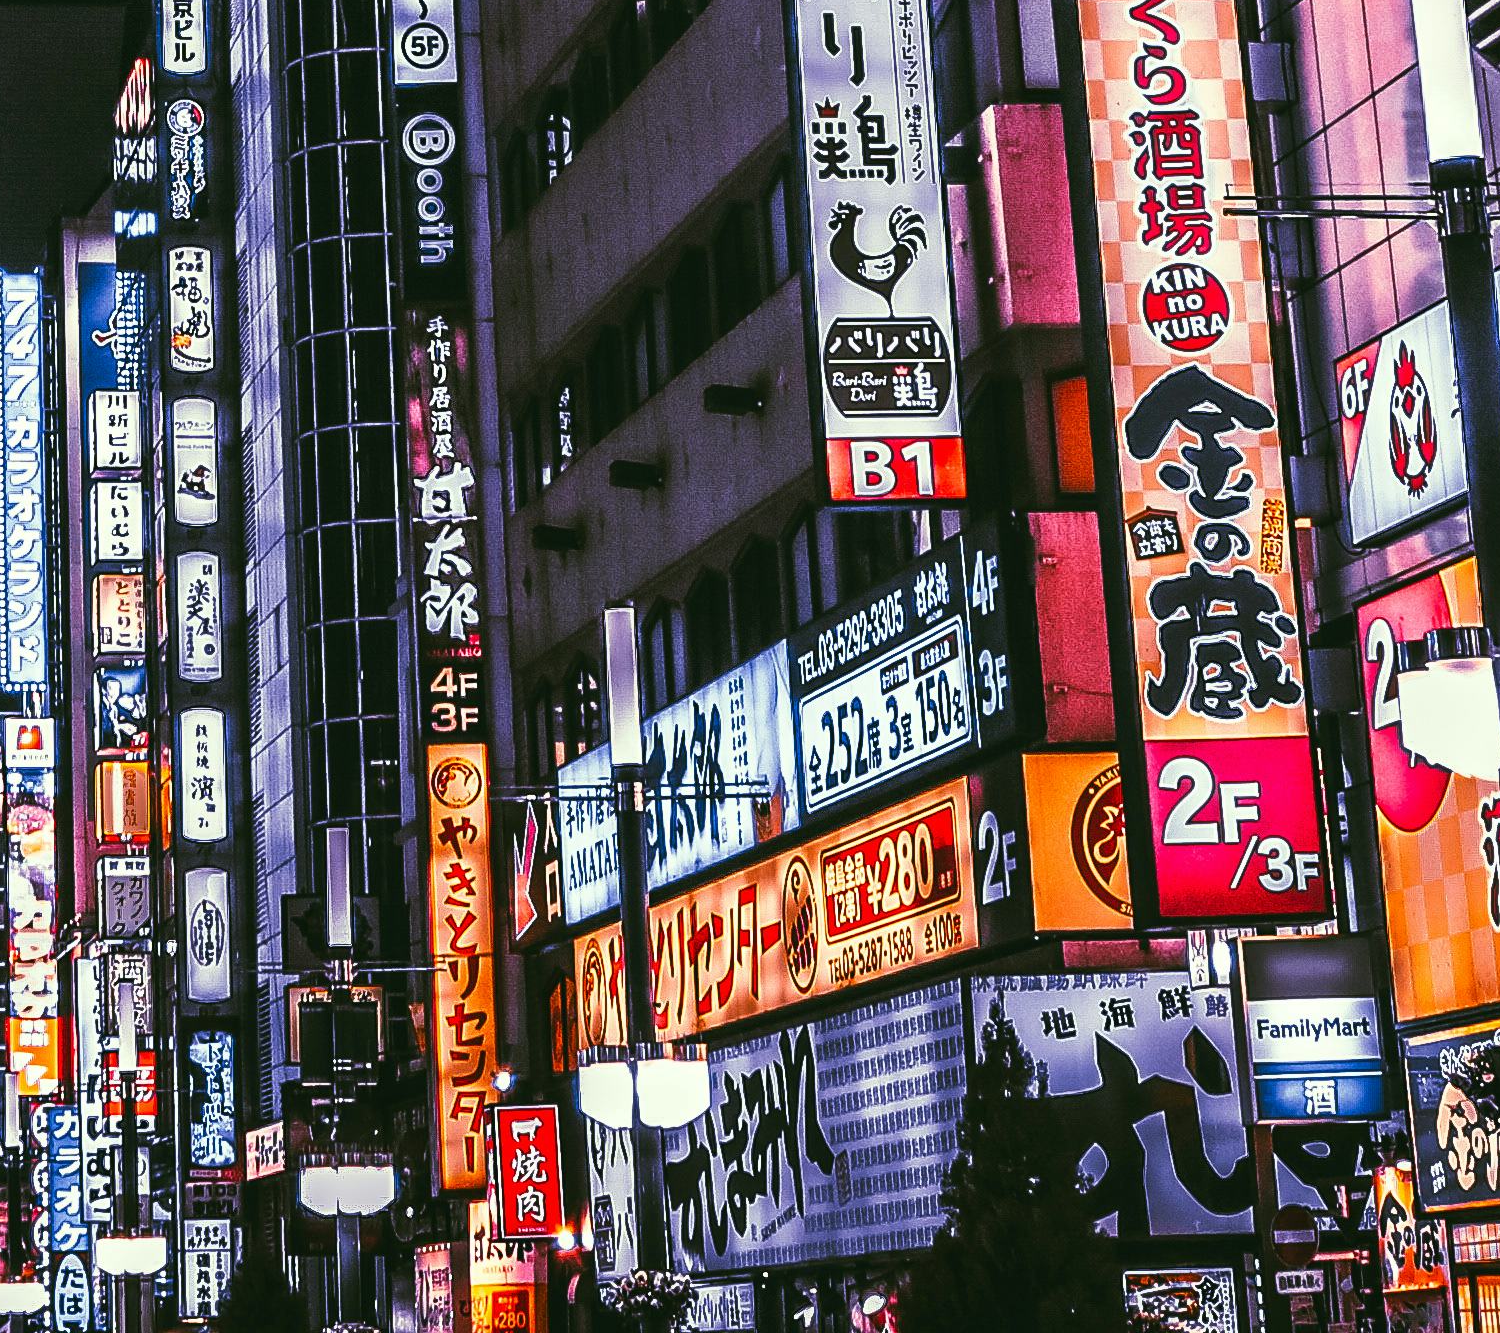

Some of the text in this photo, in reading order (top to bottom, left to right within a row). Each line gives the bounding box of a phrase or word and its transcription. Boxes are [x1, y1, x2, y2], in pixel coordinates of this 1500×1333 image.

[410, 35, 441, 57] 5F
[401, 112, 456, 266] Booth
[1149, 265, 1208, 295] KIN
[1166, 292, 1204, 314] no
[5, 290, 40, 403] 747
[828, 329, 942, 359] バリバリ
[1152, 314, 1229, 344] KURA
[426, 314, 455, 459] 手作り居酒屋
[891, 362, 939, 410] 鶏
[1340, 357, 1371, 421] 6F
[849, 440, 933, 498] B1
[5, 412, 43, 677] カラオケランド
[413, 461, 480, 641] 甘太郎
[1124, 363, 1304, 721] 金の蔵
[971, 549, 999, 615] 4F
[429, 666, 478, 698] 4F
[978, 649, 1007, 715] 3F
[430, 702, 480, 733] 3F
[1157, 755, 1261, 847] 2F
[867, 822, 934, 916] ¥280
[978, 810, 1016, 906] 2F
[438, 816, 489, 1176] やきとりセンター
[1256, 1016, 1371, 1040] FamilyMart
[1304, 1078, 1337, 1116] 酒
[53, 1109, 87, 1252] カラオケ
[510, 1148, 549, 1224] 焼肉
